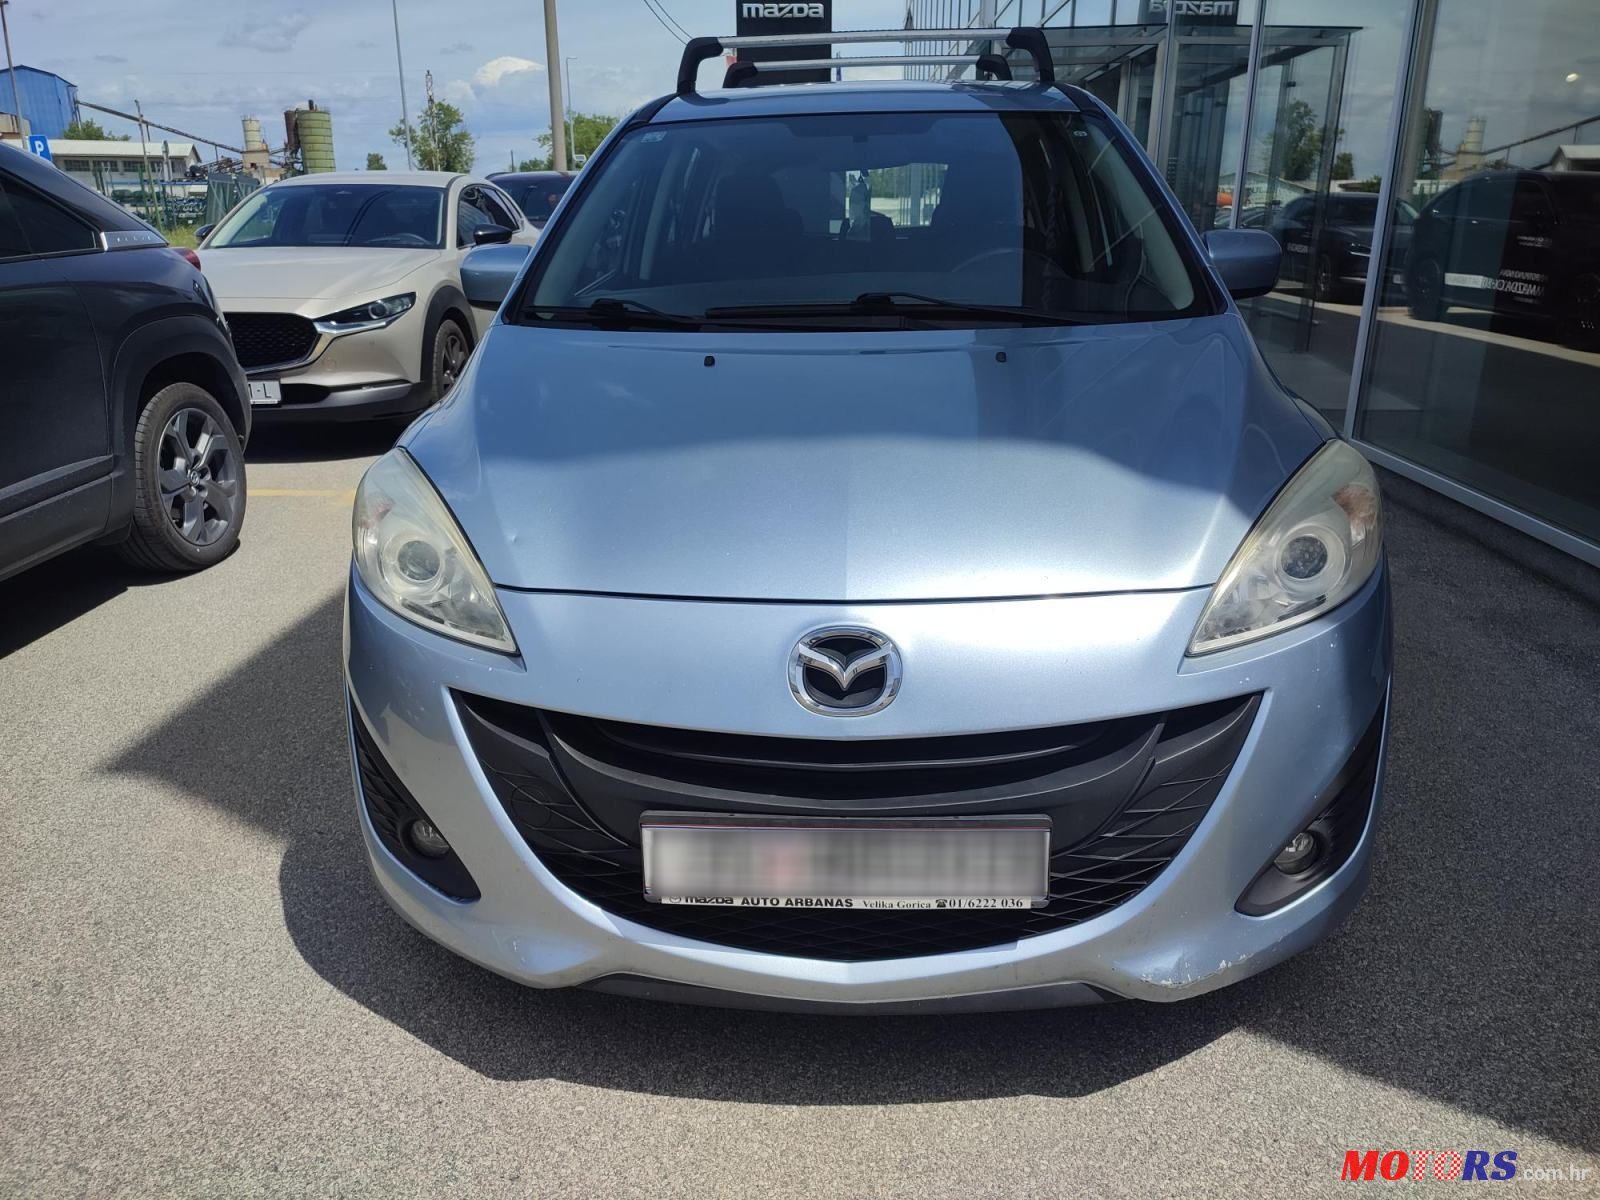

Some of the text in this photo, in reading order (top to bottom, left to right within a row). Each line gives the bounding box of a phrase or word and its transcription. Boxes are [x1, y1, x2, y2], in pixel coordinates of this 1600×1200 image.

[742, 3, 824, 18] mazda
[34, 140, 44, 157] P
[741, 896, 780, 906] AUTO
[784, 898, 854, 908] ARBANAS
[862, 899, 894, 909] Velika
[896, 900, 932, 909] Gorica
[948, 898, 997, 908] 01/6222
[1001, 898, 1023, 908] 036
